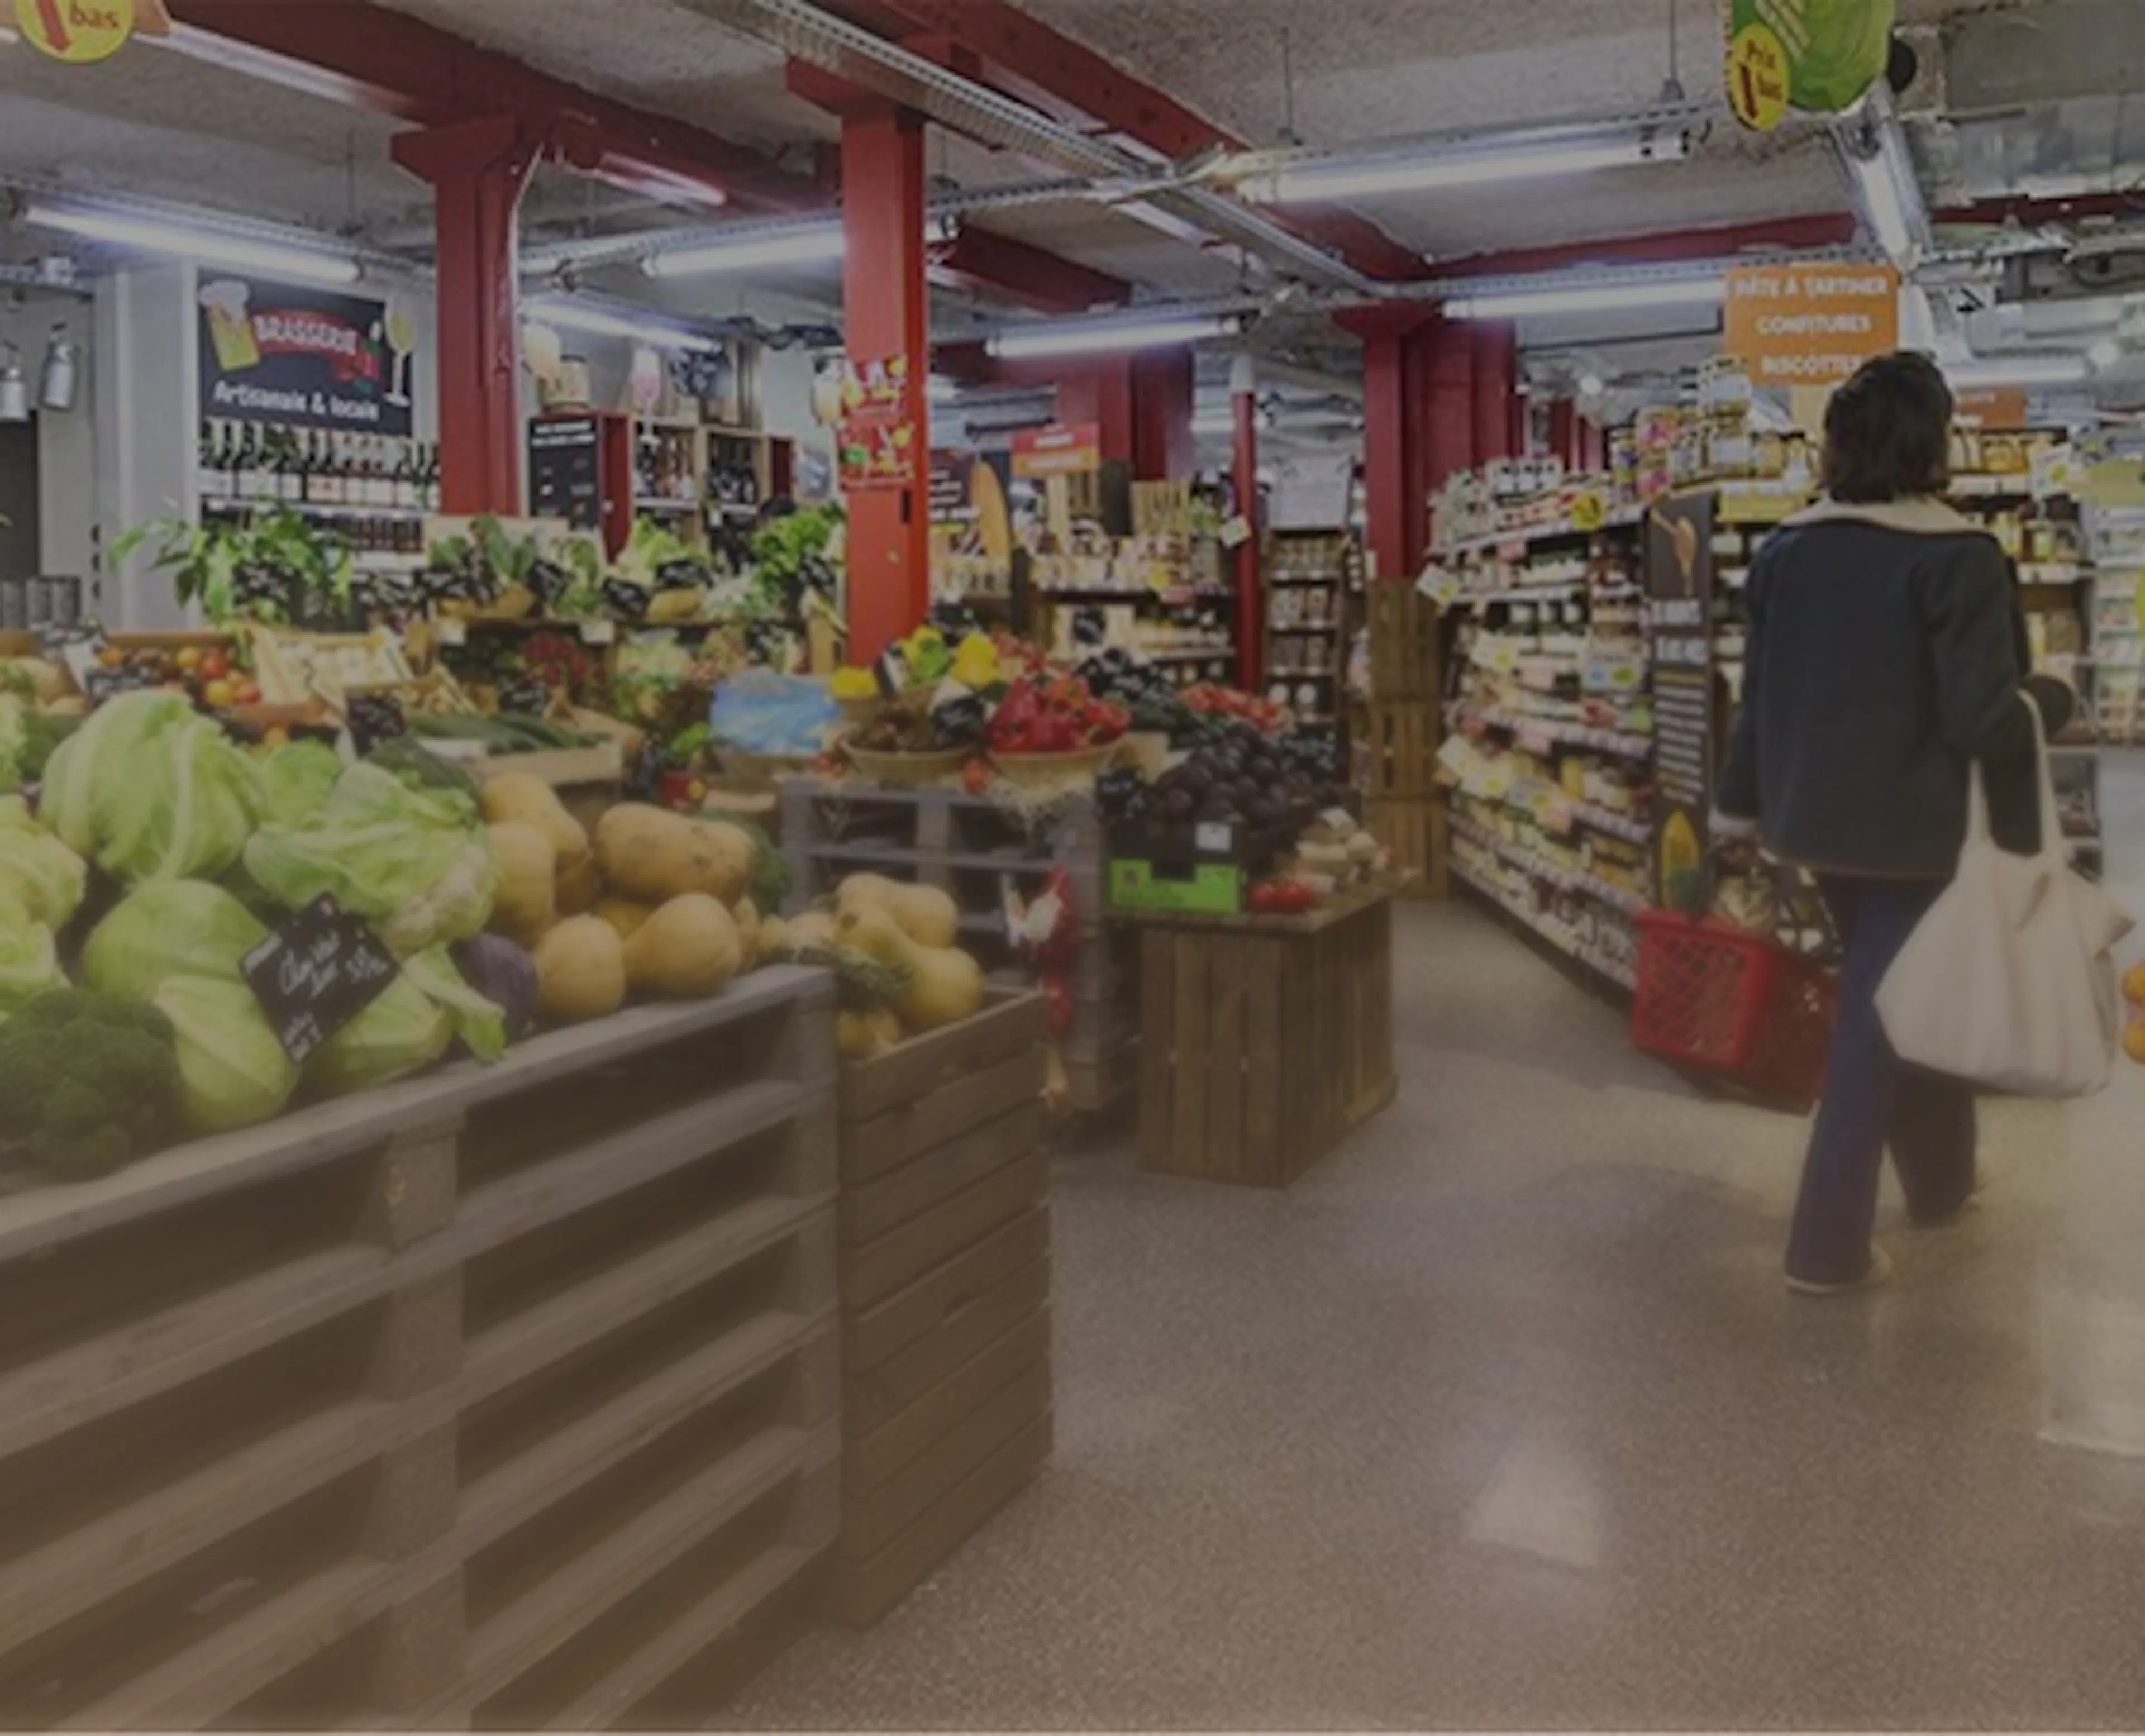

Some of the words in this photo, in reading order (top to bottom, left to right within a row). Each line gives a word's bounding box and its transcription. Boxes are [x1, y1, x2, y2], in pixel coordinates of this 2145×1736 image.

[69, 0, 119, 28] bas
[252, 313, 358, 356] BRASSERIE
[311, 391, 326, 415] &
